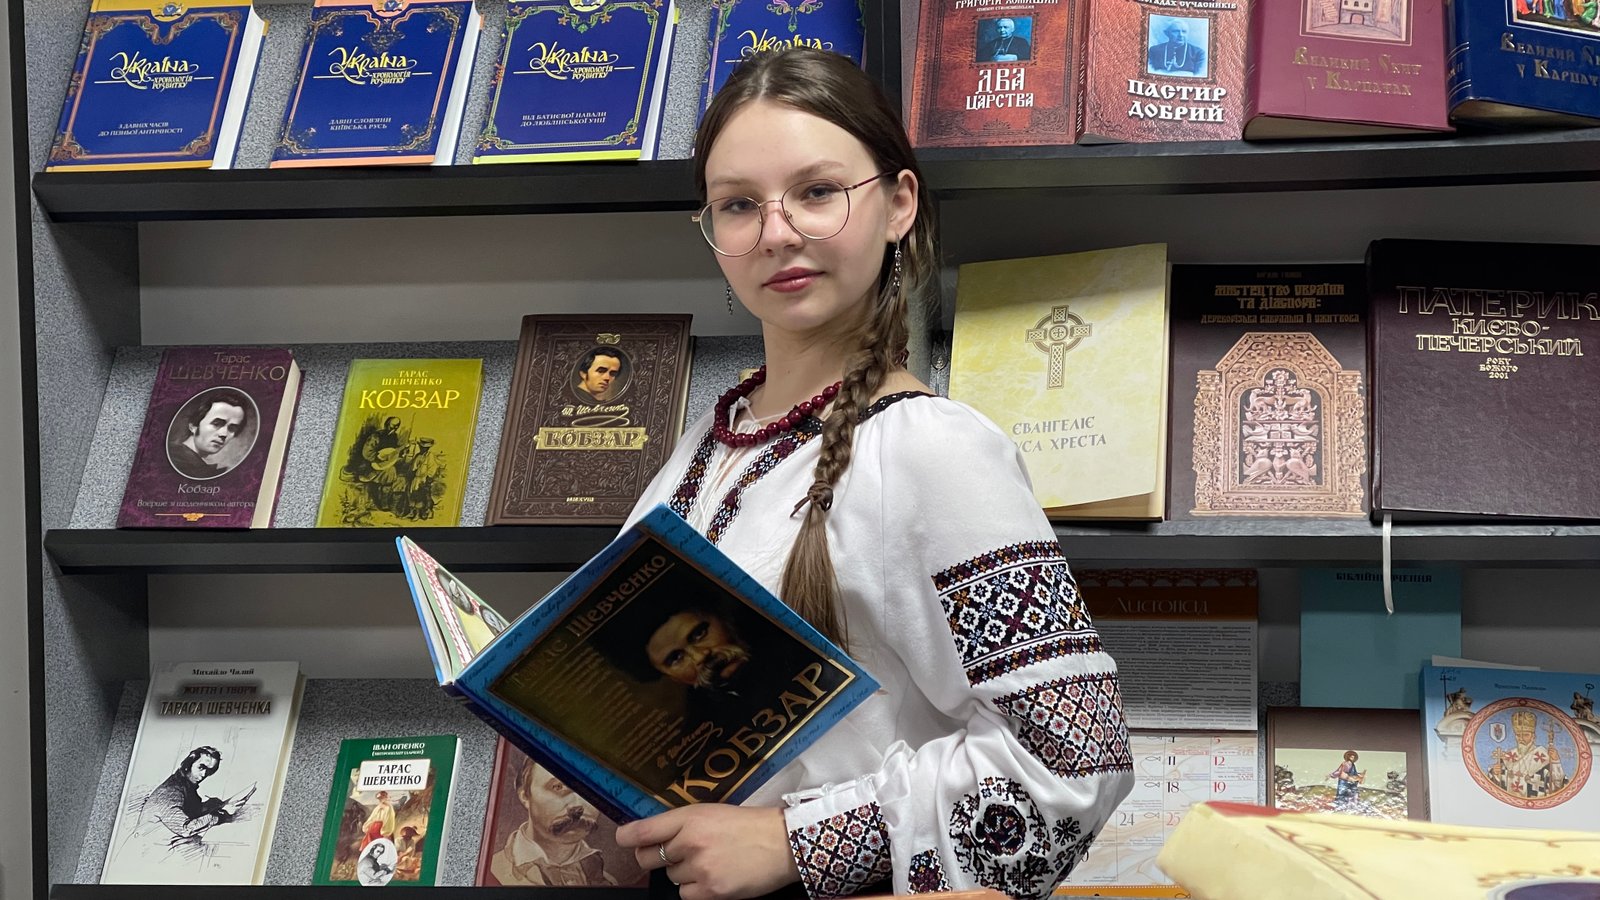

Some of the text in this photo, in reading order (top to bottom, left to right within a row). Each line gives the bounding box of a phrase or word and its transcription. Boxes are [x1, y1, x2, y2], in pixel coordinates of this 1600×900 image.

[370, 77, 405, 88] РОЗВИТКУ
[572, 72, 608, 82] РОЗВИТКУ
[976, 68, 1025, 94] ДВА
[152, 82, 189, 91] РОЗВИТКУ
[1128, 79, 1226, 102] ПАСТИР
[966, 93, 1034, 110] ЦАРСТВА
[1128, 100, 1224, 122] ДОБРИЙ
[1214, 284, 1344, 296] МИСТЕЦТВО УКРАЇНИ
[1237, 298, 1254, 308] ТА
[1396, 286, 1600, 320] ПАТЕРИК
[1452, 318, 1550, 336] КИЄВО-
[1416, 334, 1584, 356] ПЕЧЕРСЬКИЙ
[214, 352, 250, 364] Тарас
[168, 365, 286, 381] ШЕВЧЕНКО
[1479, 364, 1518, 372] БОЖОГО
[359, 390, 460, 409] КОБЗАР
[1012, 416, 1095, 436] ЄВАНГЕЛІЄ
[545, 431, 641, 448] КОБЗАР
[1050, 434, 1106, 450] ХРЕСТА
[178, 484, 220, 495] Кобзар
[137, 500, 168, 508] Вперше
[566, 554, 666, 637] Шевченко
[192, 668, 228, 676] Михайло
[184, 686, 218, 695] ЖИТТЯ
[225, 685, 258, 694] ТВОРИ
[160, 700, 272, 716] ТАРАСА ШЕВЧЕНКА
[667, 662, 827, 804] КОБЗАР
[1168, 756, 1176, 766] 11
[1214, 756, 1225, 766] 12
[378, 764, 412, 774] ТАРАС
[363, 775, 422, 786] ШЕВЧЕНКО
[1167, 781, 1180, 793] 18
[1214, 781, 1226, 793] 19
[1120, 813, 1134, 826] 24
[1166, 814, 1180, 826] 25
